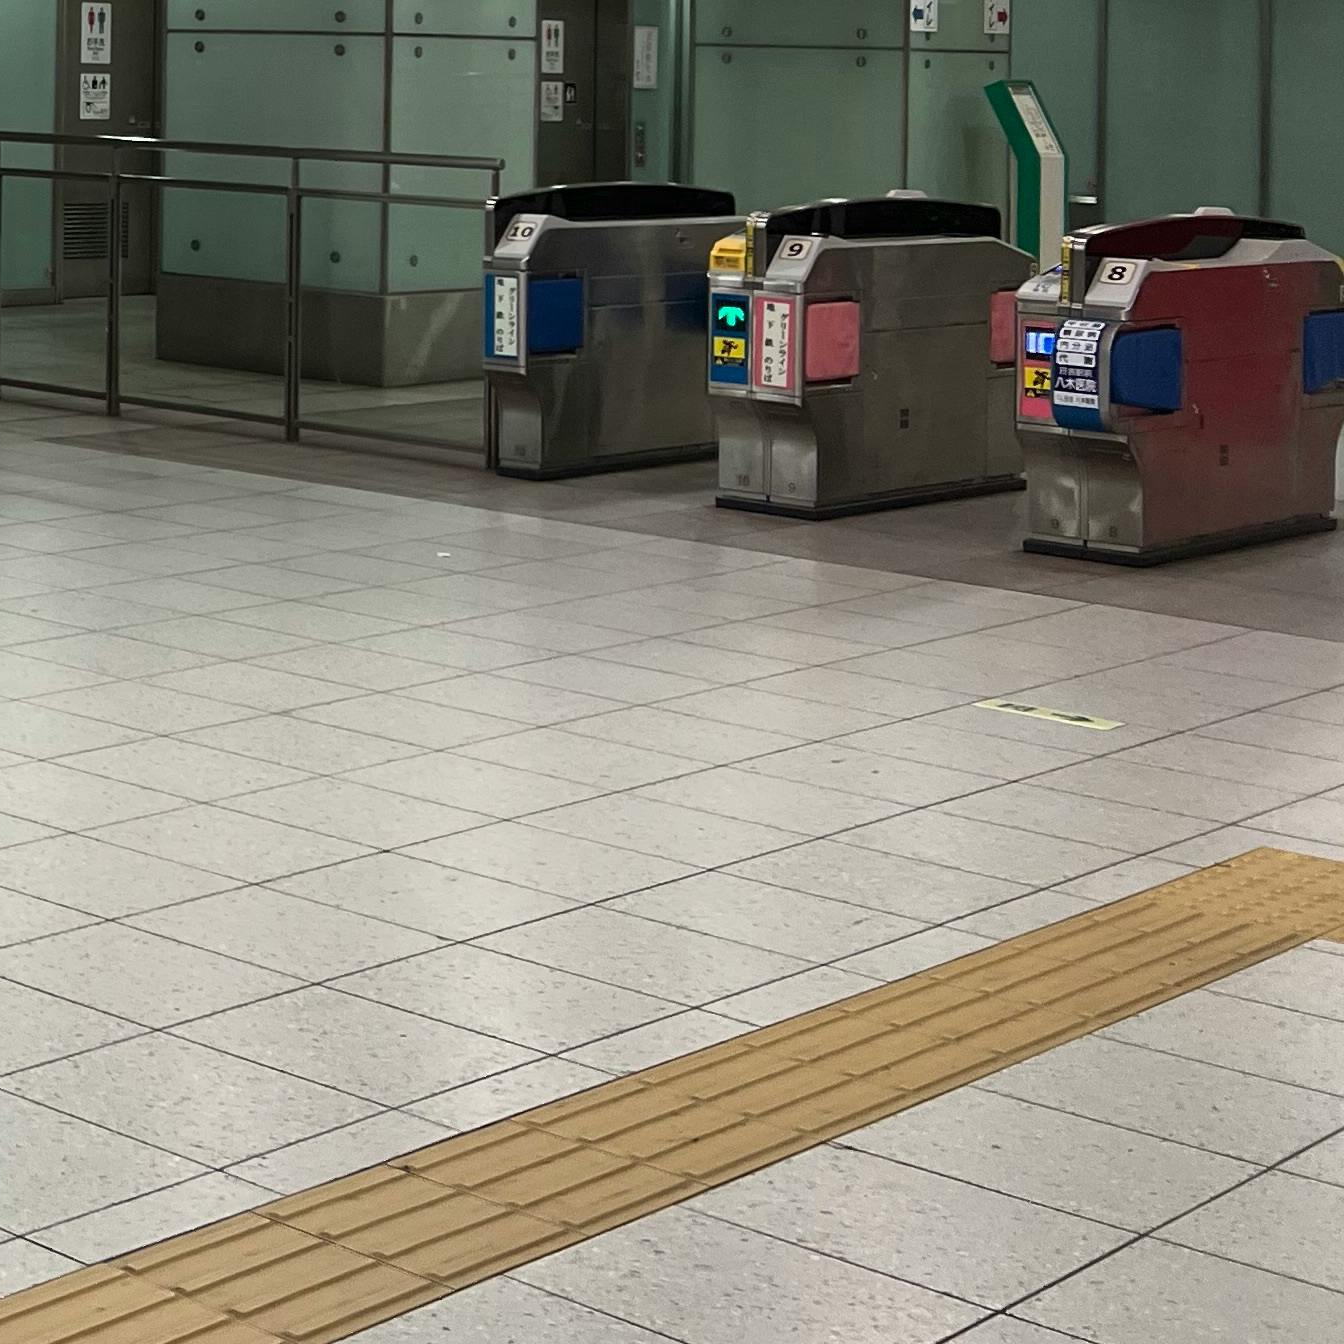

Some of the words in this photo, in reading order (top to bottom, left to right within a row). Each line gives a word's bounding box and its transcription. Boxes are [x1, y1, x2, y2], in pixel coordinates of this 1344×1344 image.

[510, 226, 534, 238] 10
[787, 243, 804, 257] 9
[1108, 266, 1127, 281] 8
